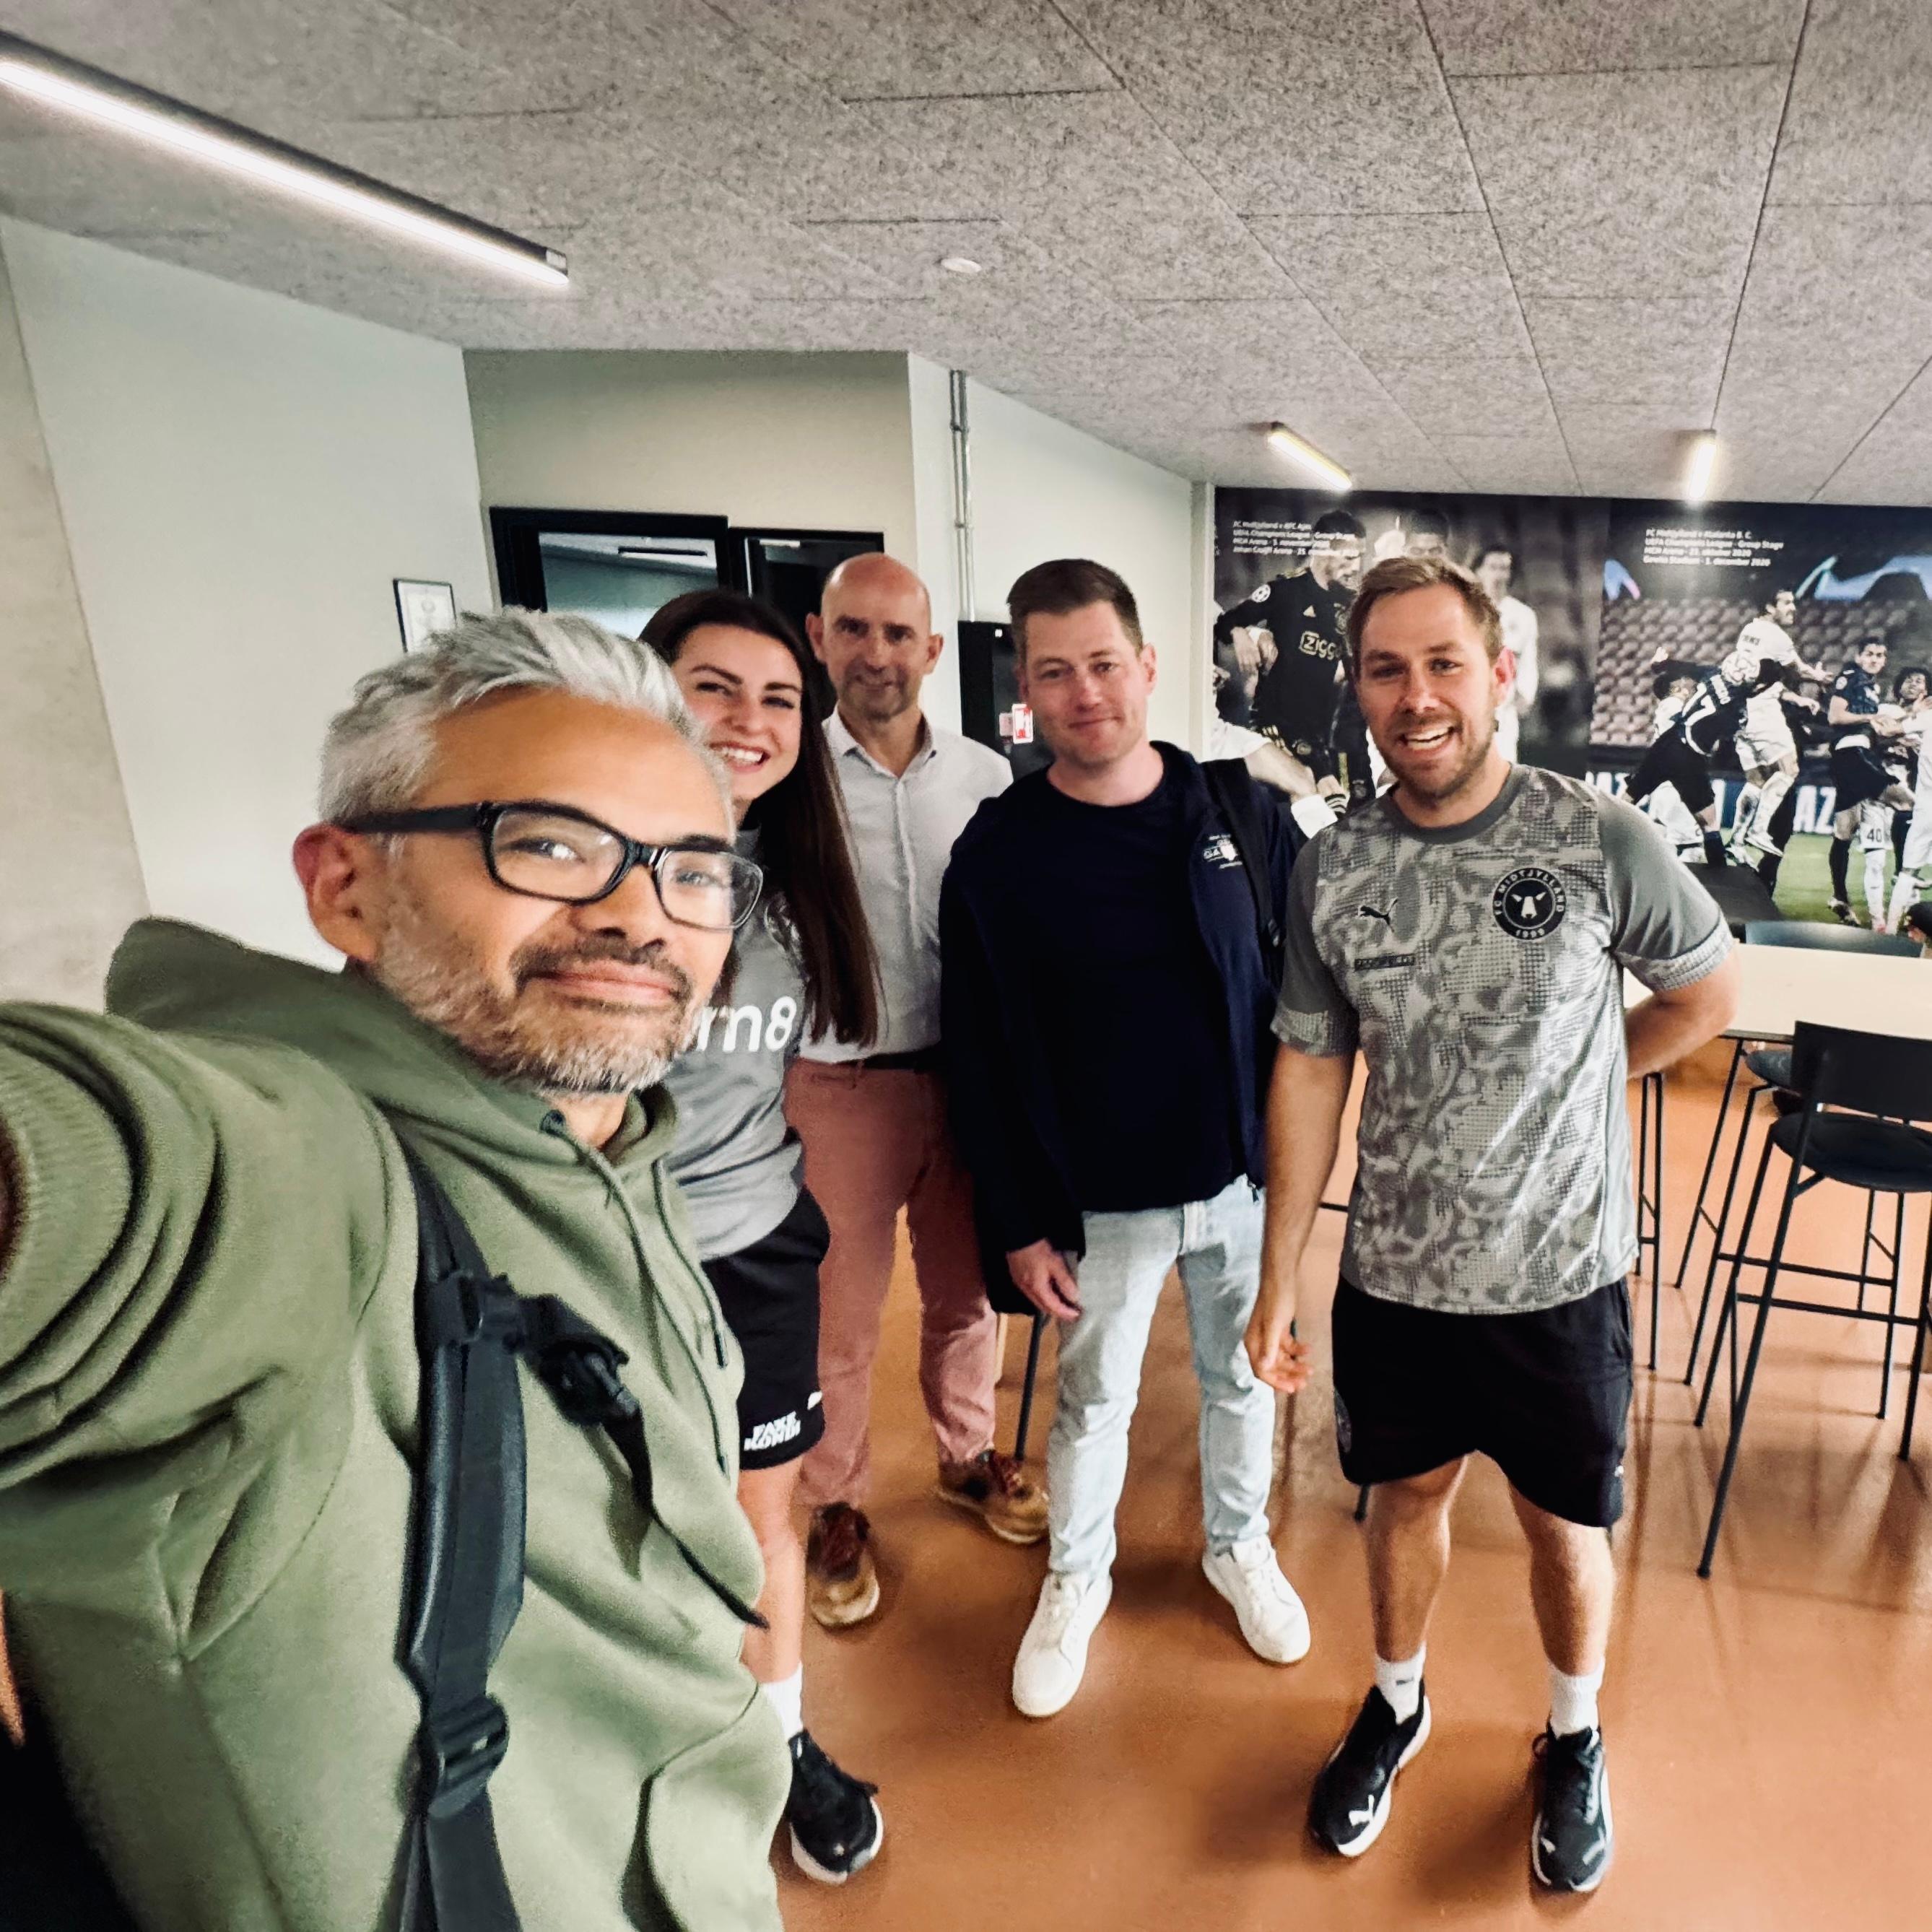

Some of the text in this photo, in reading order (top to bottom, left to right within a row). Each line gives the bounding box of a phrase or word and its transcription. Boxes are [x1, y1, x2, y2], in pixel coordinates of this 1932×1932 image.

[1646, 528, 1655, 537] FC
[1665, 539, 1705, 547] Champions
[1706, 539, 1733, 549] League
[1738, 540, 1761, 549] Group
[1762, 541, 1784, 551] Stage
[1866, 828, 1883, 843] 40
[1497, 869, 1565, 913] MIDTJYLLAND
[696, 996, 798, 1053] rn8
